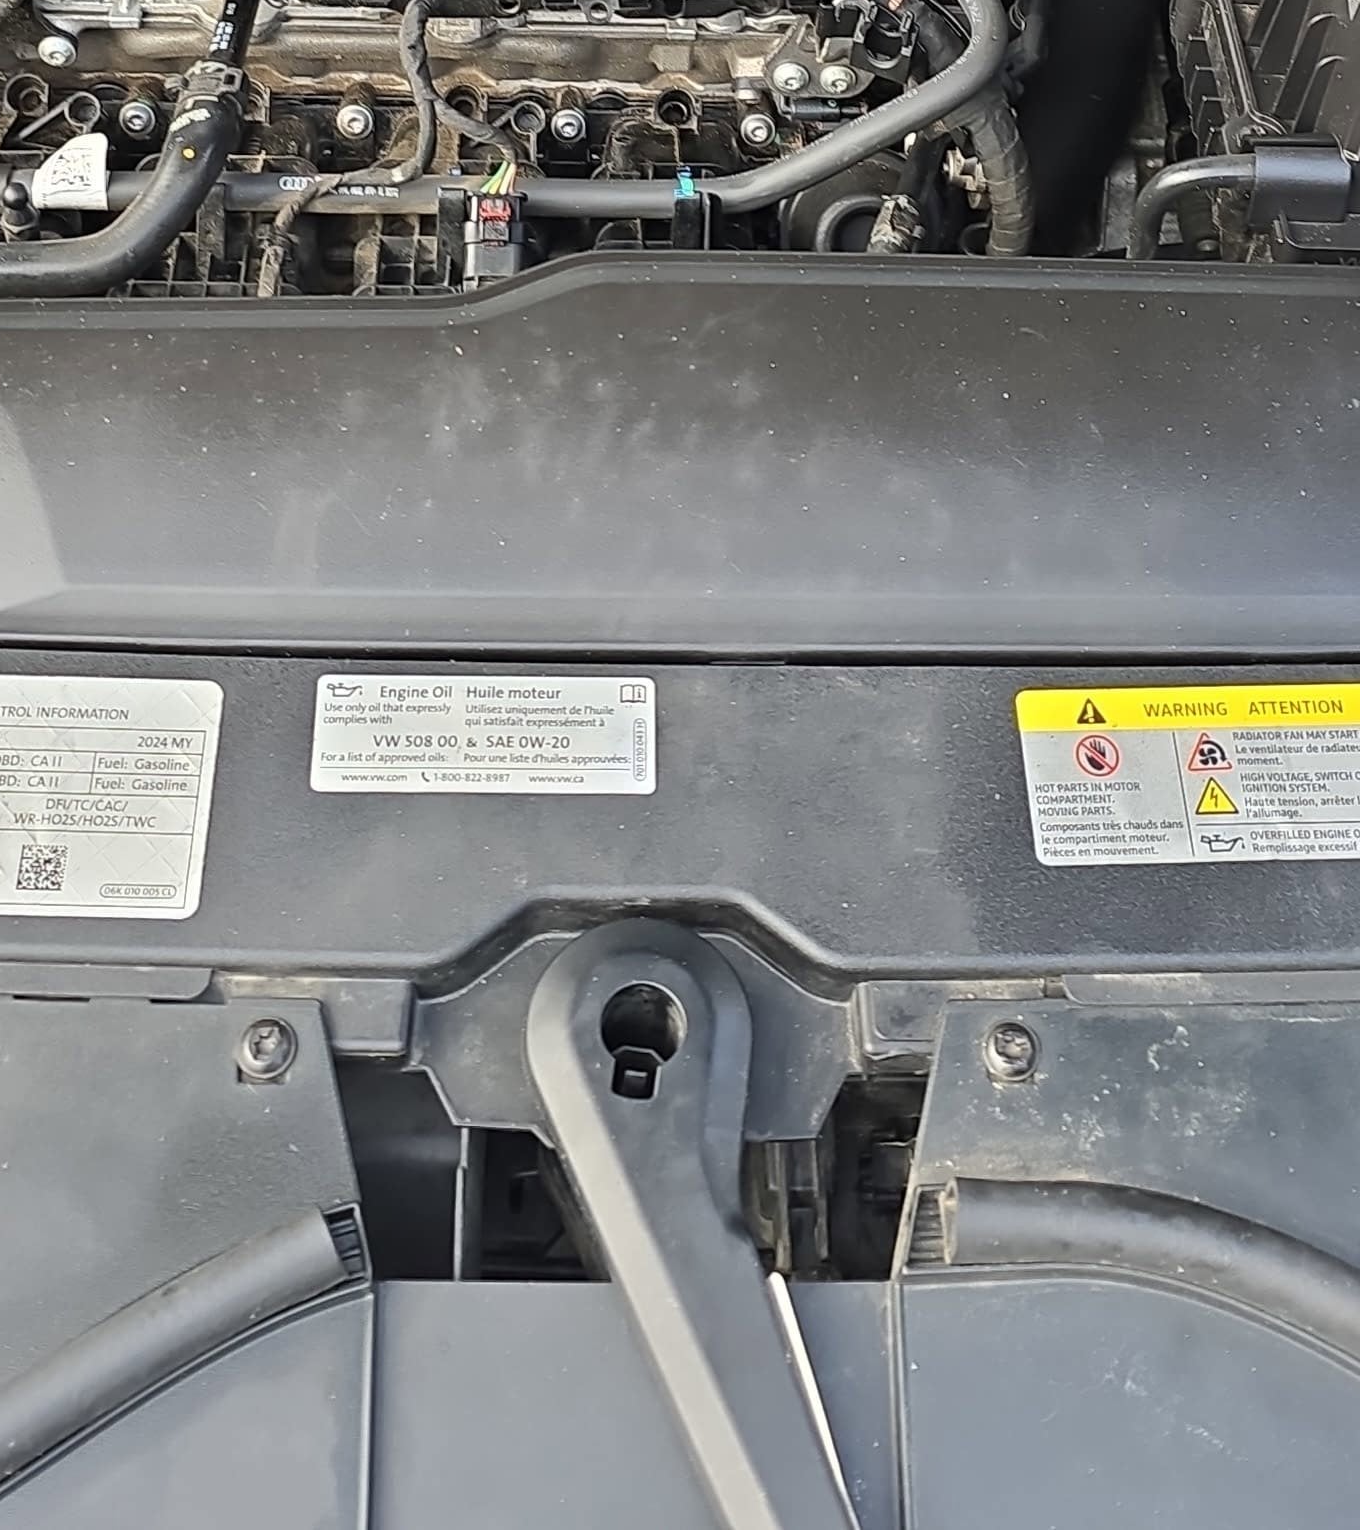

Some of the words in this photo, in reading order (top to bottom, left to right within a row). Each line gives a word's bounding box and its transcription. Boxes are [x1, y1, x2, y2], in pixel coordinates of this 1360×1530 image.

[380, 686, 428, 701] Engine
[433, 686, 452, 698] Oil
[467, 687, 504, 698] Huile
[509, 688, 562, 699] moteur
[37, 707, 129, 720] INFORMATION
[325, 704, 343, 712] Use
[345, 704, 366, 714] only
[368, 704, 380, 712] oil
[383, 704, 403, 712] that
[405, 704, 451, 714] expressly
[466, 705, 502, 714] Utilisez
[505, 705, 567, 717] uniquement
[569, 706, 582, 715] de
[584, 706, 614, 715] l'huile
[1143, 702, 1228, 717] WARNING
[1249, 699, 1344, 715] ATTENTION
[323, 715, 368, 726] complies
[370, 716, 393, 724] with
[465, 718, 481, 728] qui
[483, 717, 524, 726] satisfait
[526, 718, 595, 729] expressément
[599, 718, 605, 727] à
[1233, 731, 1282, 740] RADIATOR
[1284, 731, 1304, 740] FAN
[1306, 730, 1327, 740] MAY
[1329, 730, 1359, 739] START
[137, 736, 167, 748] 2024
[172, 737, 193, 748] MY
[373, 735, 400, 747] VW
[405, 735, 433, 747] 508
[437, 735, 458, 748] 00
[466, 737, 477, 748] &
[486, 736, 514, 748] SAE
[519, 736, 570, 749] 0W-20
[1235, 745, 1247, 754] Le
[1249, 745, 1303, 754] ventilateur
[1306, 744, 1319, 753] de
[31, 755, 51, 767] CA
[321, 753, 337, 761] For
[347, 752, 363, 761] list
[365, 752, 376, 762] of
[378, 752, 426, 764] approved
[428, 753, 448, 762] oils:
[464, 753, 486, 763] Pour
[488, 755, 507, 763] une
[509, 754, 529, 763] liste
[531, 754, 569, 763] d'huiles
[571, 754, 631, 765] approuvées:
[1238, 757, 1283, 766] moment.
[98, 758, 127, 769] Fuel:
[135, 758, 189, 771] Gasoline
[28, 776, 48, 787] CA
[341, 774, 407, 782] www.vw.com
[433, 773, 510, 782] 1-800-822-8987
[528, 775, 584, 783] www.vw.ca
[1240, 772, 1266, 782] HIGH
[1267, 772, 1313, 782] VOLTAGE,
[1315, 771, 1353, 780] SWITCH
[95, 778, 124, 789] Fuel:
[132, 779, 187, 791] Gasoline
[1035, 784, 1055, 793] HOT
[1057, 783, 1089, 792] PARTS
[1091, 783, 1102, 792] IN
[1104, 782, 1141, 792] MOTOR
[1242, 783, 1287, 793] IGNITION
[1289, 783, 1330, 792] SYSTEM.
[46, 798, 128, 812] DFI/TC/CAC/
[1036, 794, 1115, 805] COMPARTMENT.
[1245, 797, 1276, 807] Haute
[1277, 797, 1318, 807] tension,
[1320, 796, 1355, 806] arrêter
[1038, 807, 1079, 817] MOVING
[1081, 806, 1116, 815] PARTS.
[1246, 808, 1302, 819] l'allumage.
[15, 813, 157, 828] WR-HO2S/HO2S/TWC
[1040, 822, 1101, 833] Composants
[1102, 821, 1121, 831] très
[1123, 820, 1158, 830] chauds
[1160, 820, 1184, 829] dans
[1041, 835, 1051, 844] le
[1053, 834, 1127, 846] compartiment
[1129, 833, 1170, 842] moteur.
[1250, 830, 1311, 841] OVERFILLED
[1313, 830, 1351, 839] ENGINE
[1043, 847, 1076, 857] Pièces
[1078, 848, 1091, 857] en
[1093, 846, 1159, 856] mouvement.
[1253, 843, 1317, 854] Remplissage
[1318, 842, 1357, 851] excessif
[124, 887, 140, 895] 010
